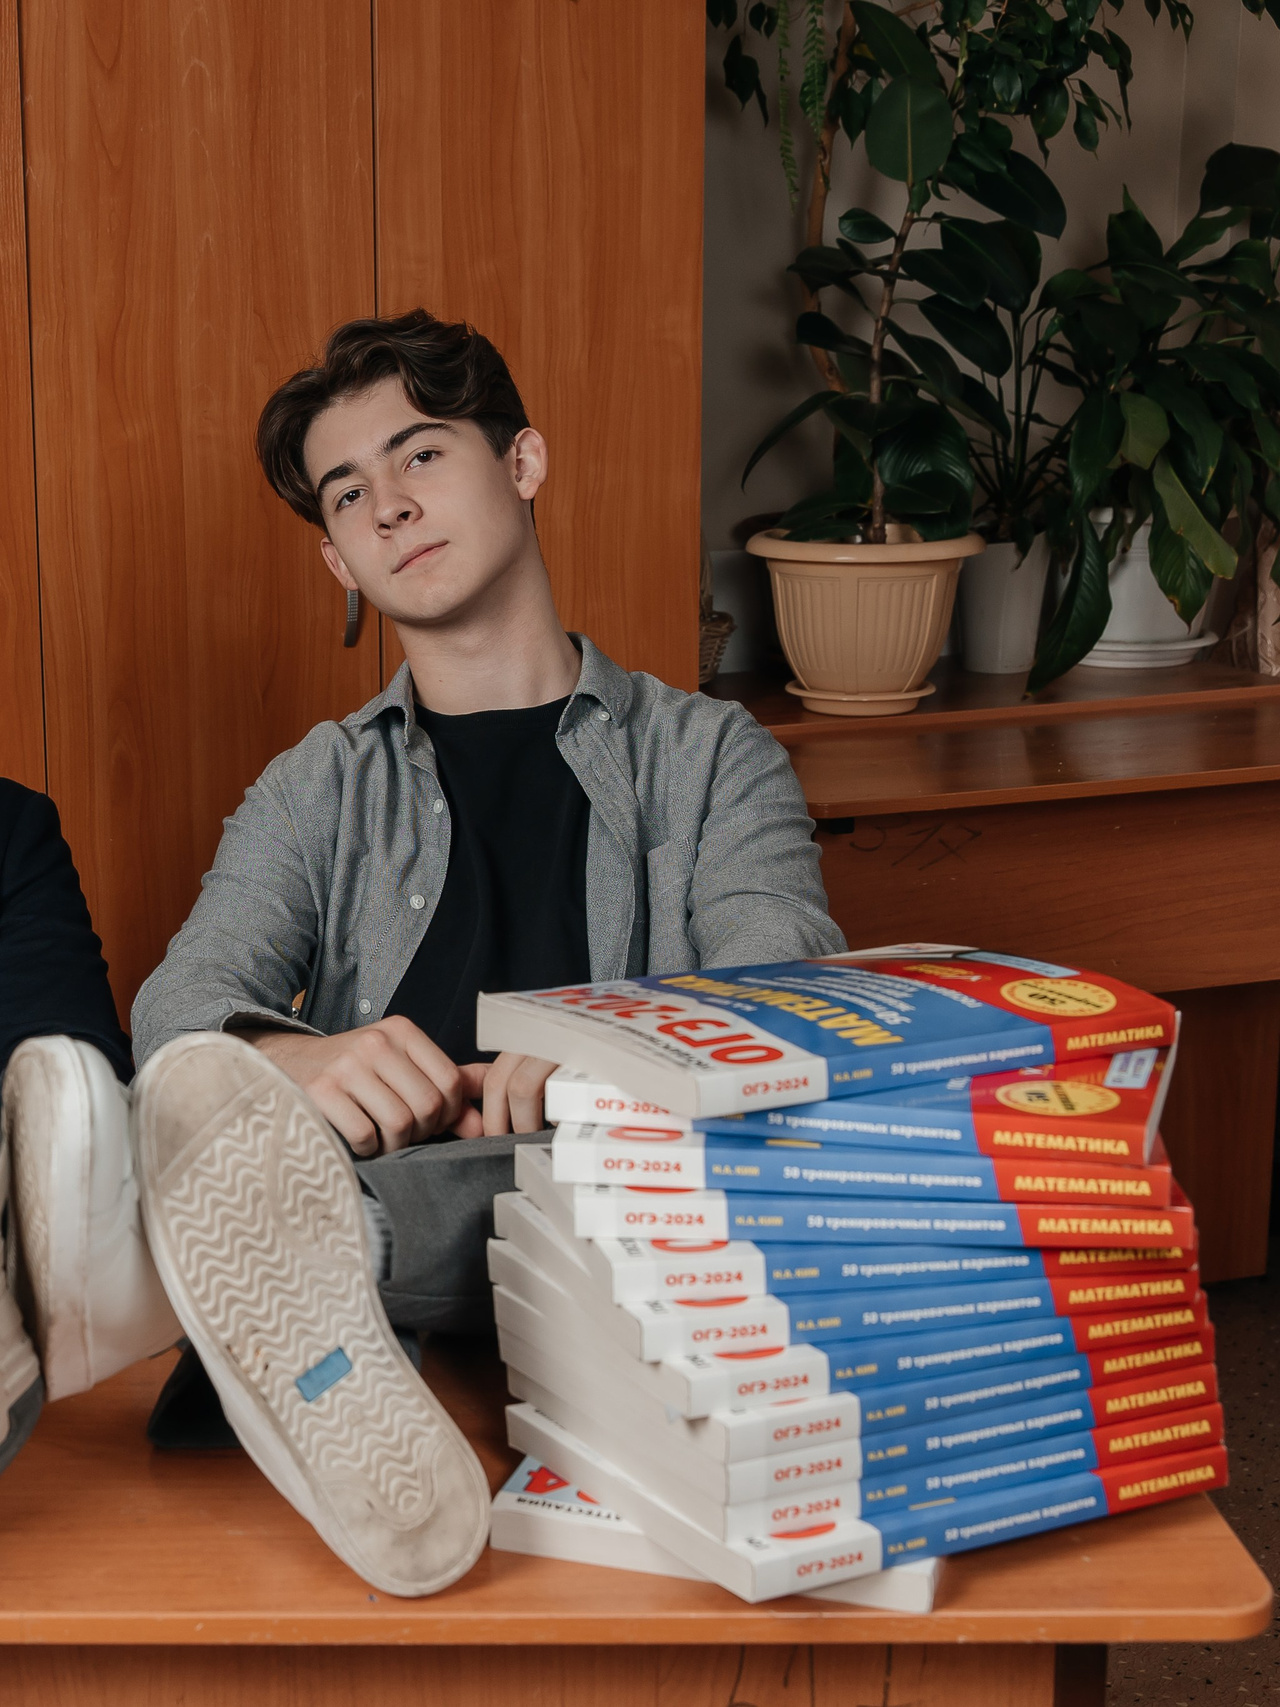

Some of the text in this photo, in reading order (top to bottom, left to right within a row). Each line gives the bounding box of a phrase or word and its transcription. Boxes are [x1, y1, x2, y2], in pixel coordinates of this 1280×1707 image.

[743, 1026, 1164, 1096] ОГЭ-2024 50 тренировочных вариантов МАТЕМАТИКА
[768, 1113, 784, 1124] 50
[786, 1116, 888, 1134] тренировочных
[890, 1124, 962, 1140] вариантов
[993, 1130, 1130, 1155] МАТЕМАТИКА
[604, 1159, 1151, 1196] ОГЭ-2024 50 тренировочных вариантов МАТЕМАТИКА
[625, 1212, 1173, 1235] ОГЭ-2024 50 тренировочных вариантов МАТЕМАТИКА
[666, 1271, 743, 1286] ОГЭ-2024
[842, 1264, 858, 1276] 50
[860, 1259, 960, 1276] тренировочных
[962, 1256, 1029, 1271] вариантов
[692, 1279, 1184, 1341] ОГЭ-2024 50 тренировочных вариантов МАТЕМАТИКА
[738, 1374, 809, 1395] ОГЭ-2024
[1088, 1309, 1194, 1339] МАТЕМАТИКА
[773, 1418, 841, 1441] ОГЭ-2024
[1104, 1341, 1202, 1374] МАТЕМАТИКА
[774, 1459, 842, 1481] ОГЭ-2024
[1106, 1381, 1206, 1414] МАТЕМАТИКА
[772, 1499, 840, 1521] ОГЭ-2024
[1109, 1420, 1210, 1453] МАТЕМАТИКА
[797, 1553, 863, 1577] ОГЭ-2024
[1119, 1465, 1215, 1500] МАТЕМАТИКА
